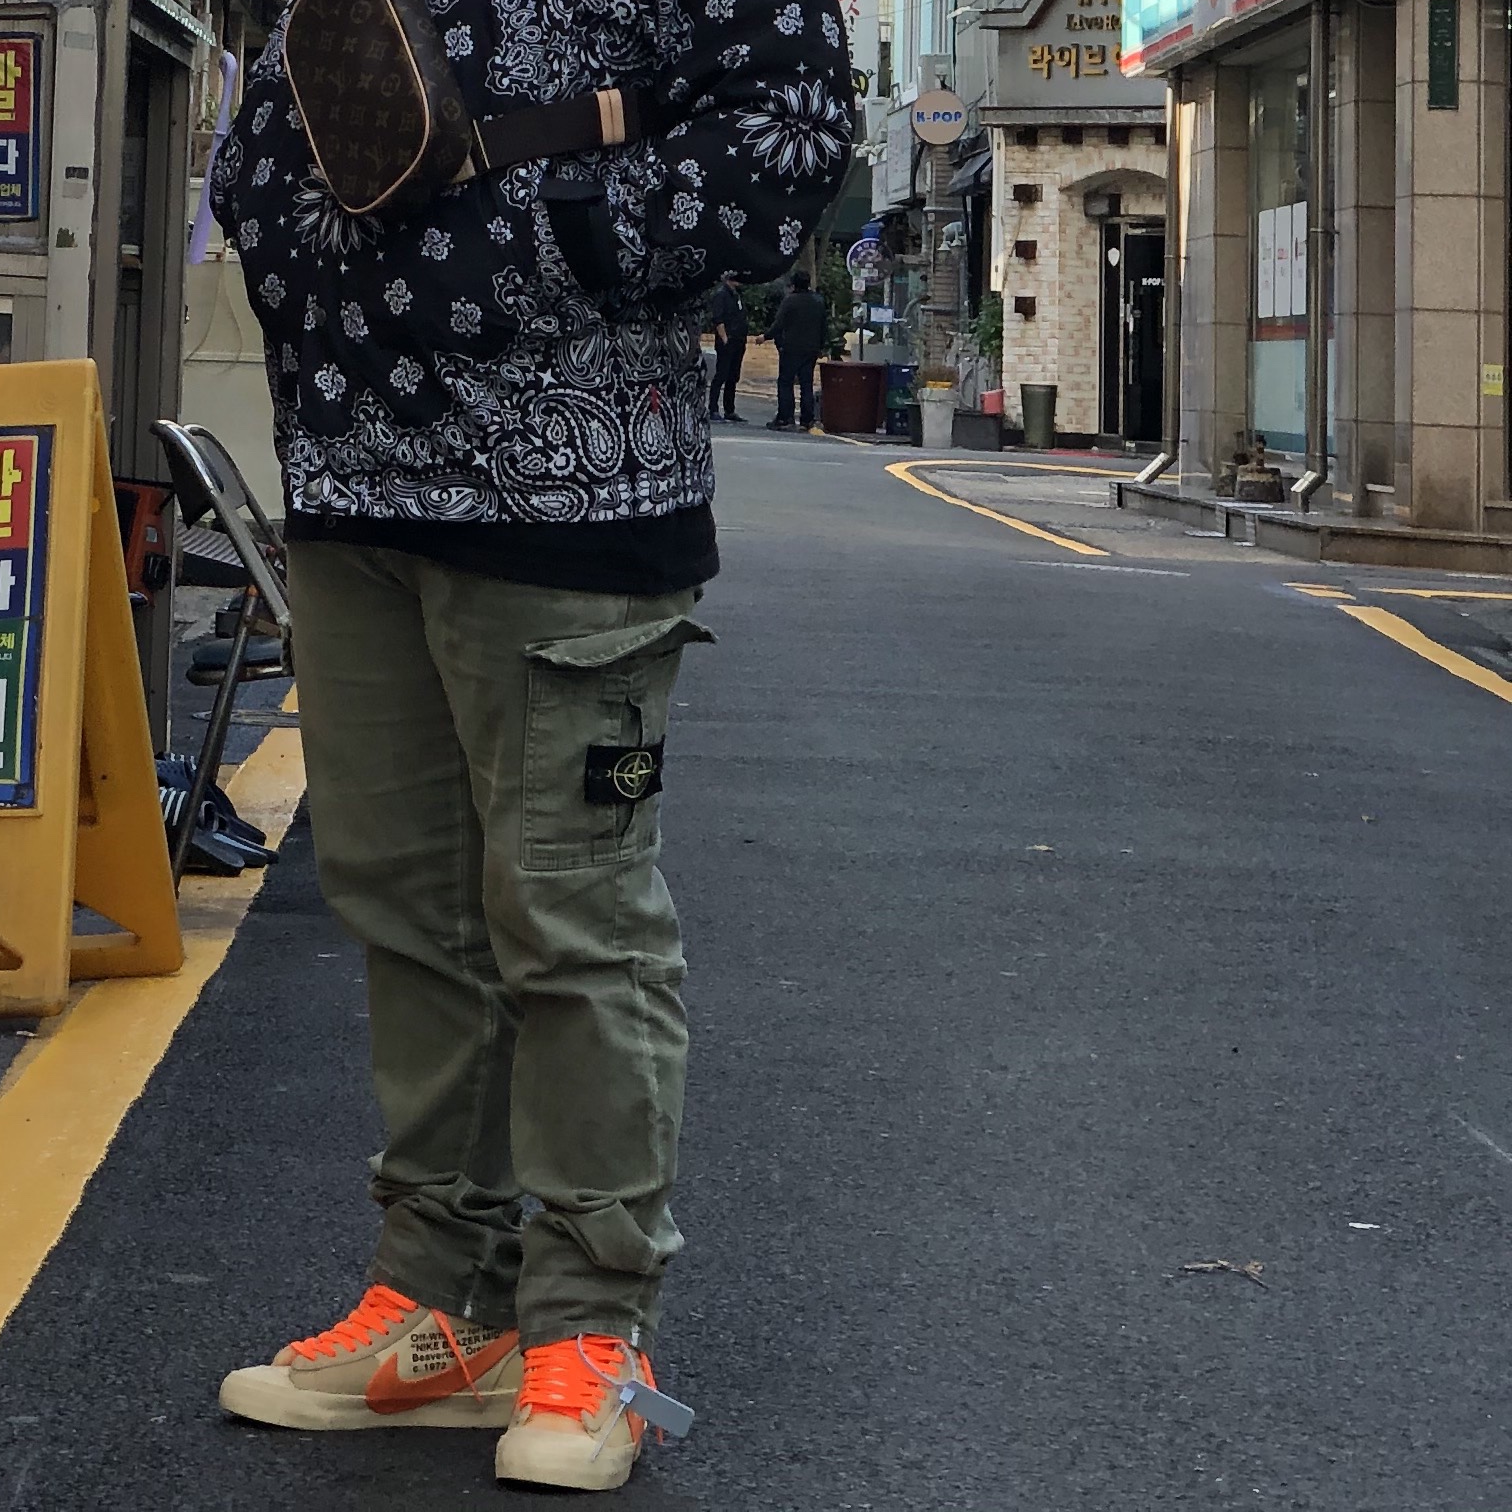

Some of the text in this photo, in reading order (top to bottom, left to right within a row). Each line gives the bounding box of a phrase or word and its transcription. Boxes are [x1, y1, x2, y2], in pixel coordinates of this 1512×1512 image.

[1028, 43, 1108, 80] 라이브
[916, 110, 963, 124] K-POP
[441, 1335, 481, 1350] BAZER
